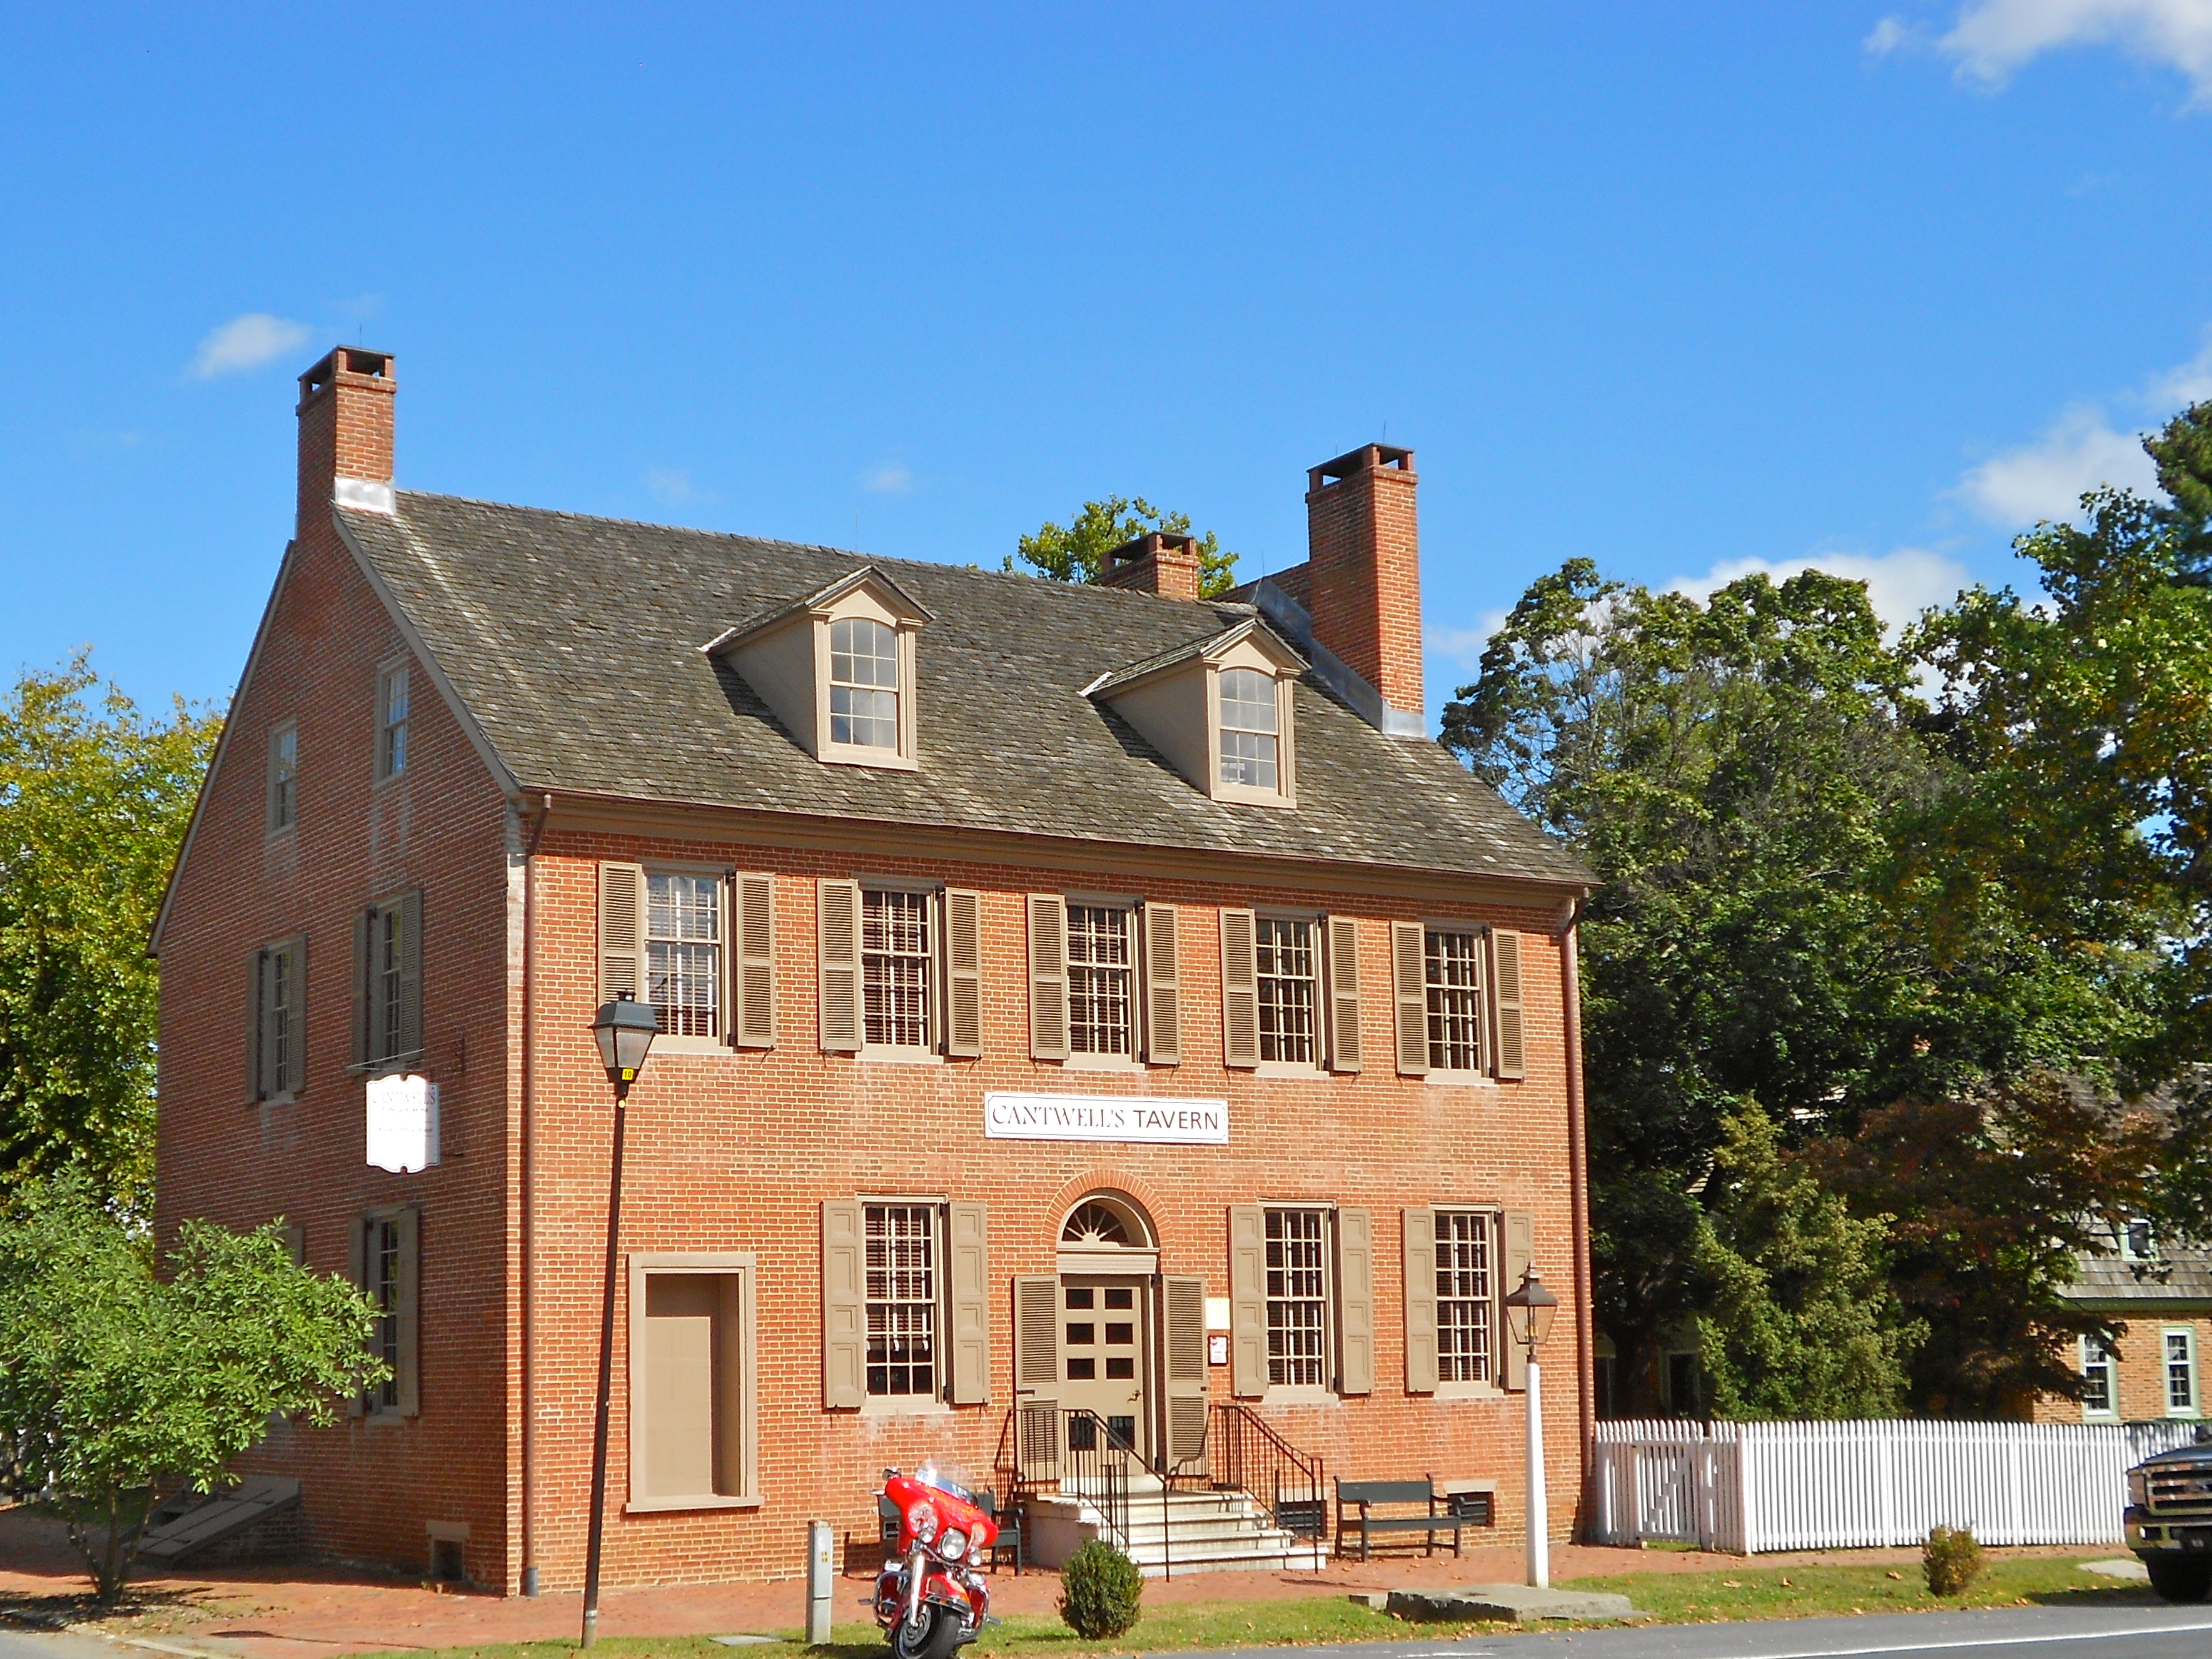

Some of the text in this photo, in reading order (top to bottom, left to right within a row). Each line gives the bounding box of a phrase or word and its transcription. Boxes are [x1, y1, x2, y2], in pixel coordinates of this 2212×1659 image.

[372, 1091, 436, 1105] ANWELL'S
[992, 1105, 1218, 1130] CANTWELL'S TAVERN
